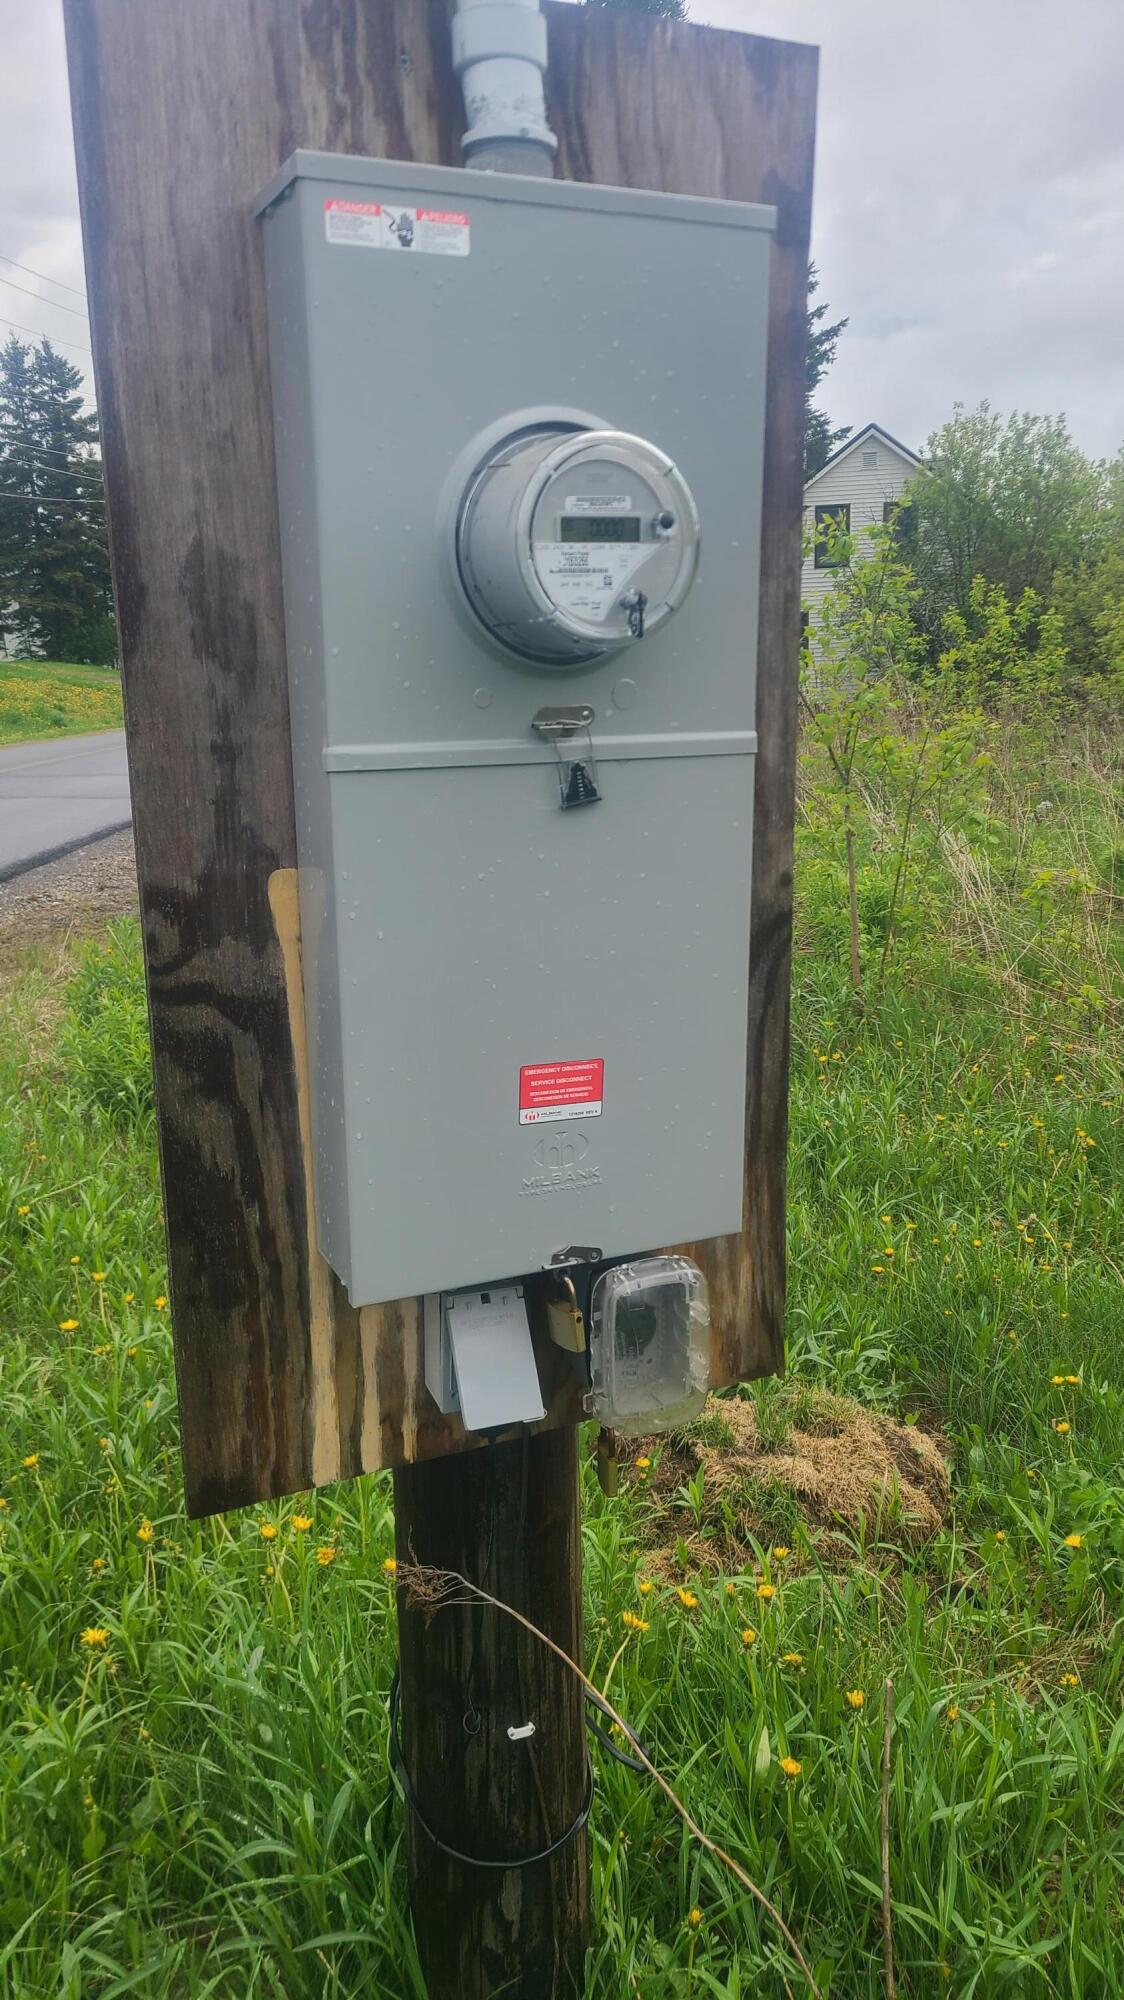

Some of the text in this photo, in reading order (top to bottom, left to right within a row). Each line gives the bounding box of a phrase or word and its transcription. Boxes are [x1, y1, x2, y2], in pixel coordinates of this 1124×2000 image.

[525, 1067, 560, 1076] EMERGENCY
[530, 1075, 592, 1087] SERVICE DISCONNECT
[522, 1165, 600, 1190] MILBANK
